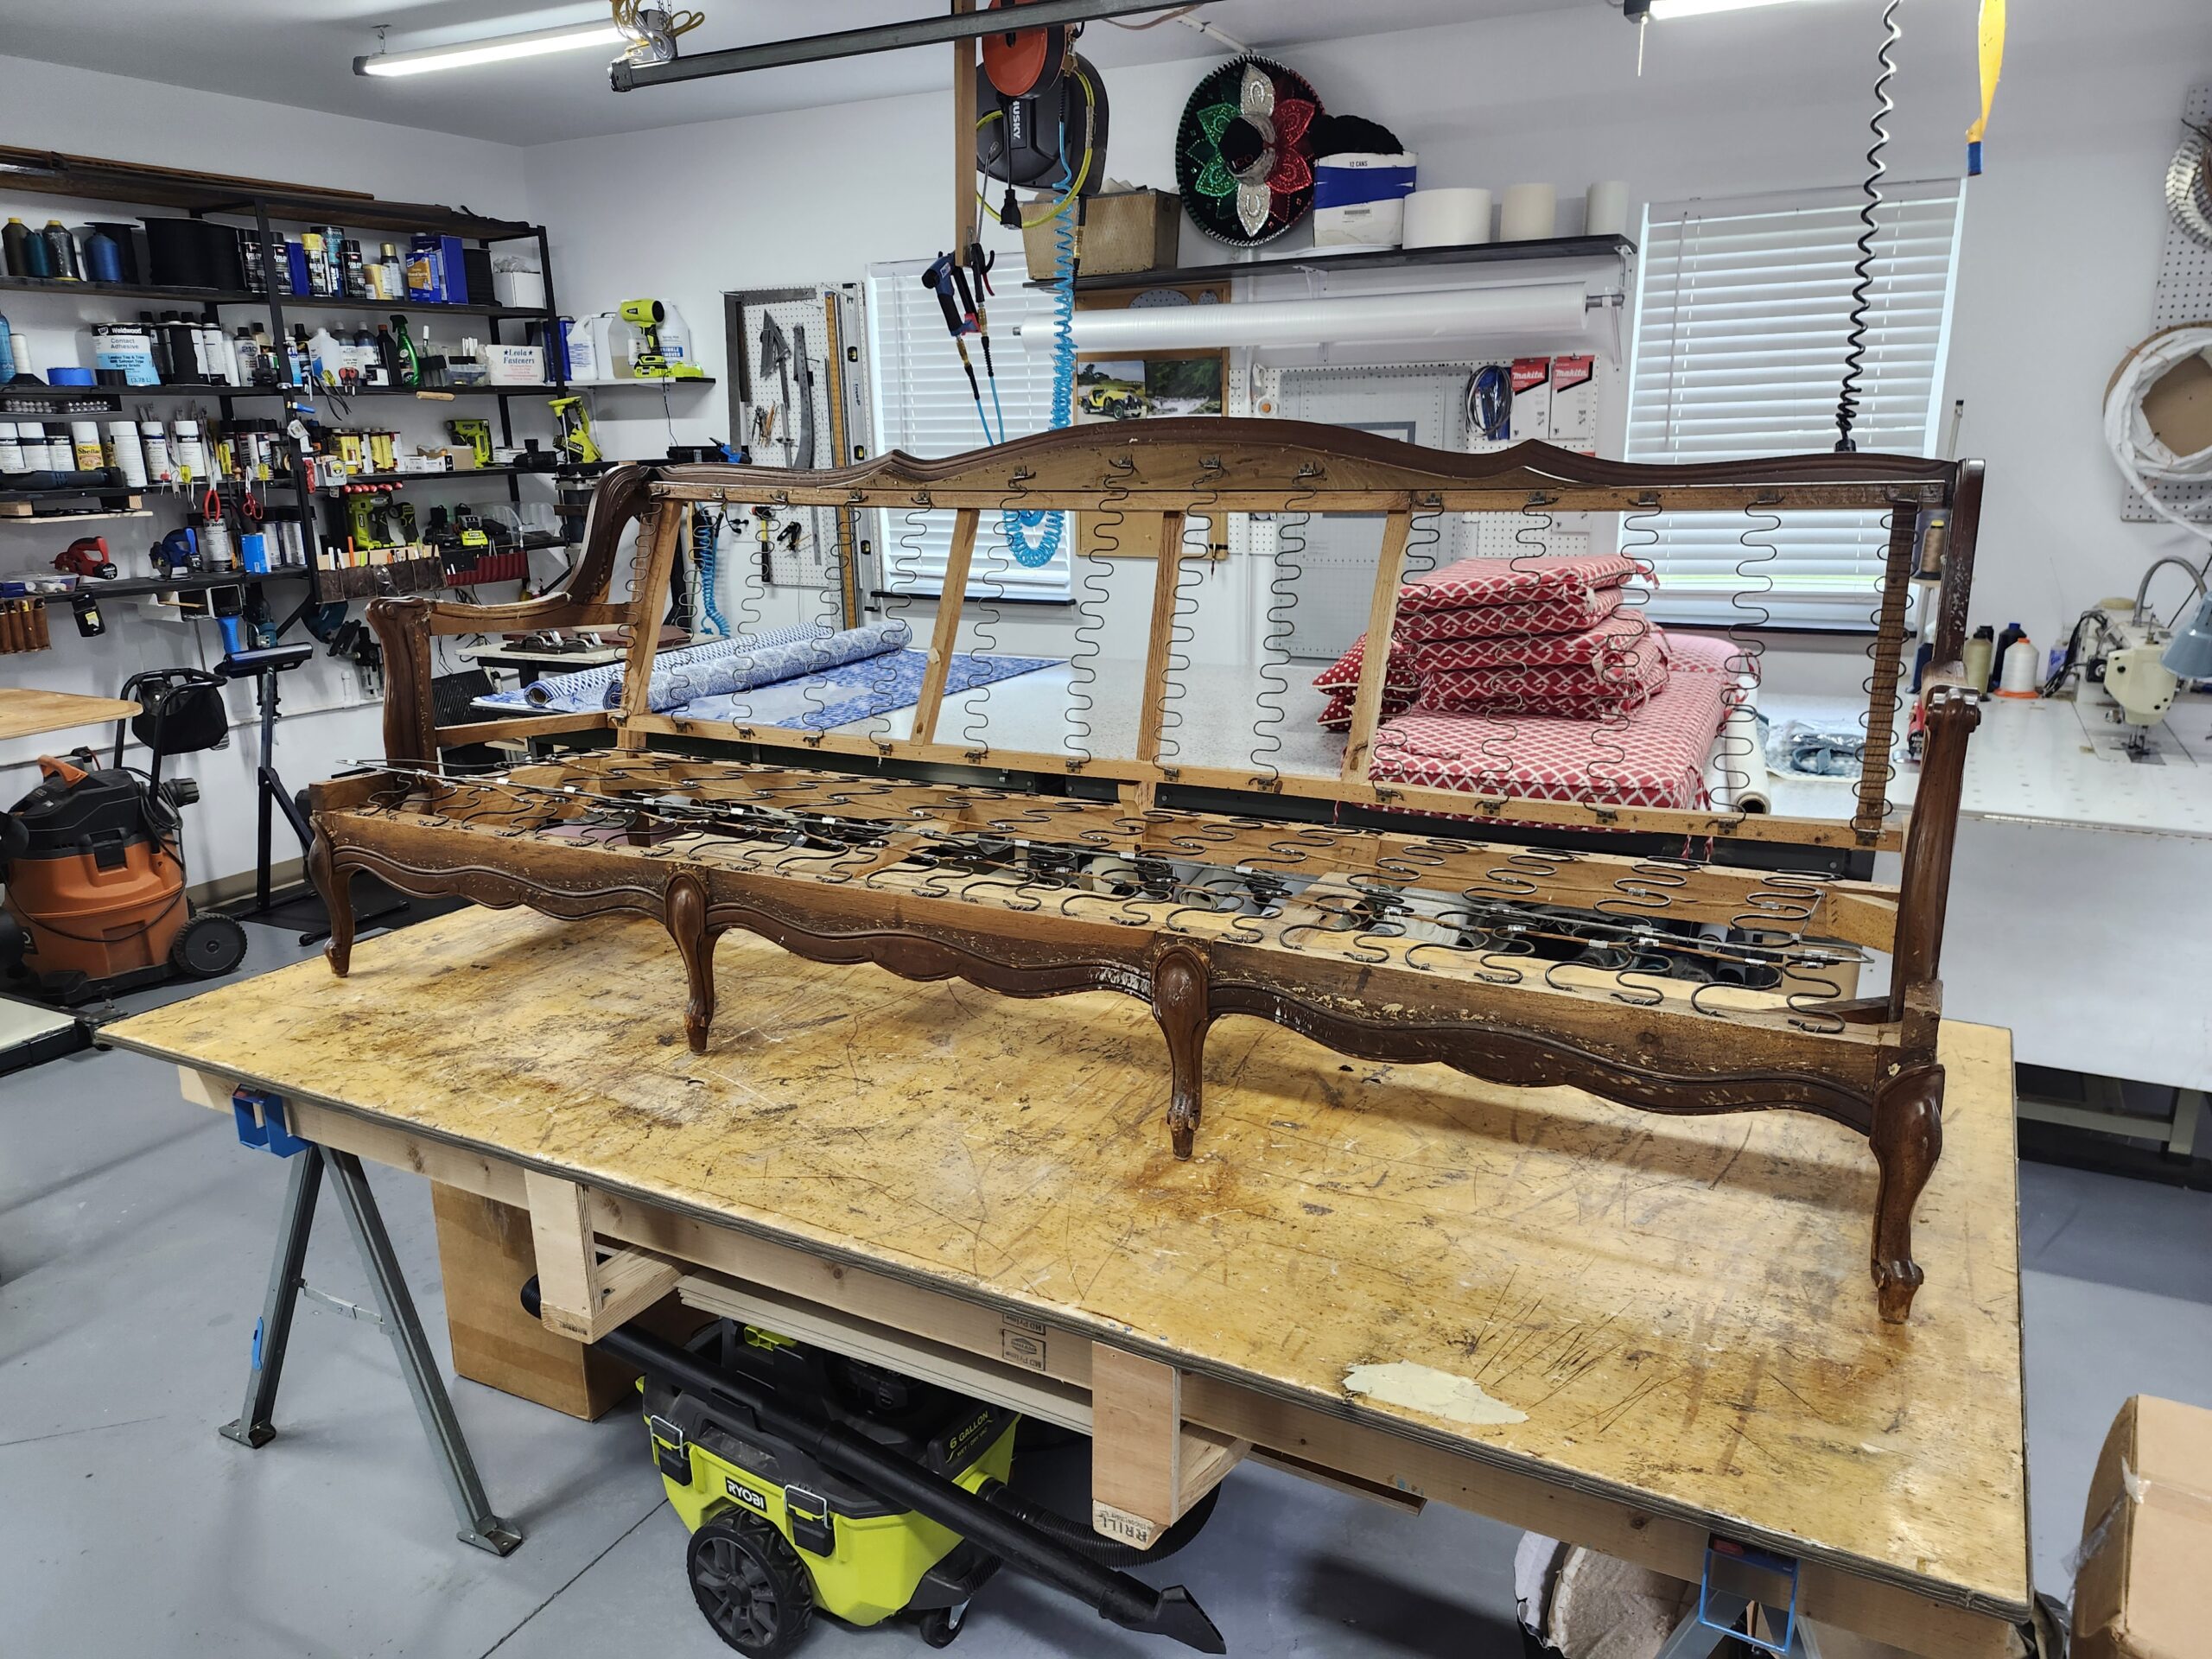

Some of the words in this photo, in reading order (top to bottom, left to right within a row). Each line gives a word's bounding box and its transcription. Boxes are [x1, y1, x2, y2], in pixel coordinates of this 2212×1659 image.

[950, 1437, 957, 1449] 6
[958, 1410, 988, 1442] GALLON
[727, 1479, 765, 1510] RYOBI
